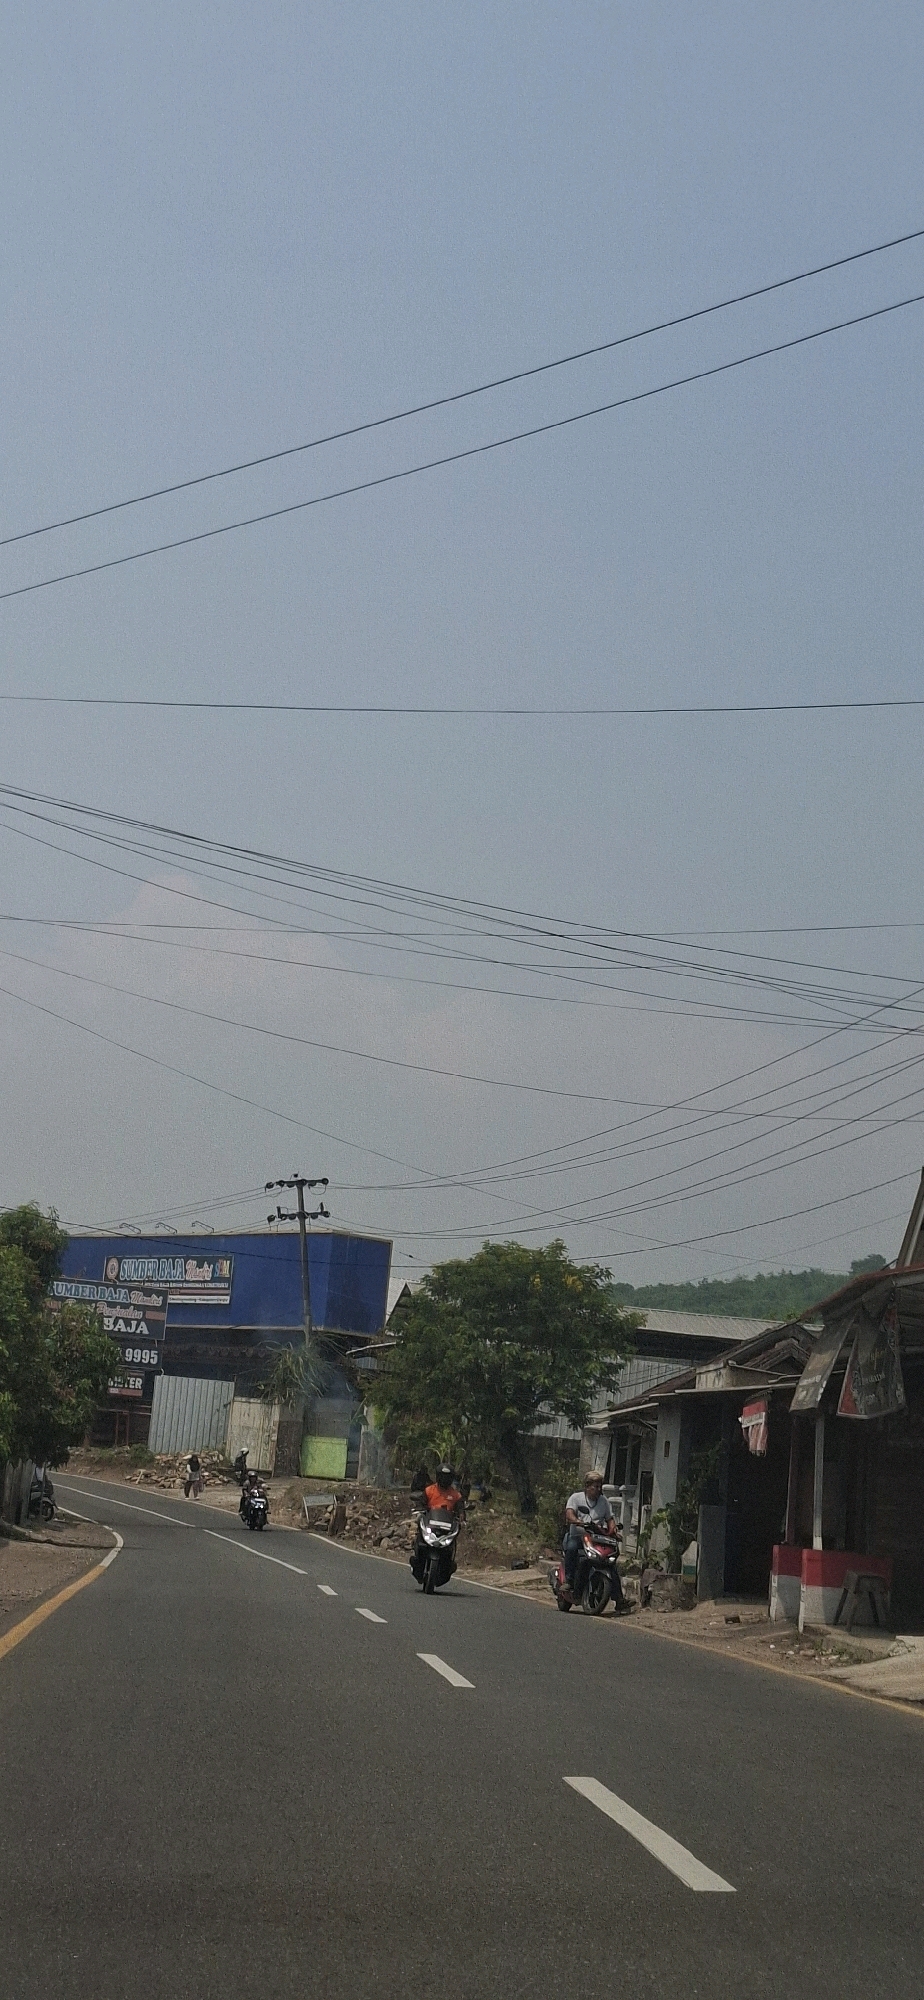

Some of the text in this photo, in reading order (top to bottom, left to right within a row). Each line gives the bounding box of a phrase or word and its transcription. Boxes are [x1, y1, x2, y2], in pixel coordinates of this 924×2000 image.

[120, 1258, 160, 1281] SUMBER
[159, 1258, 186, 1281] BAJA
[97, 1287, 131, 1304] BAJA
[103, 1317, 150, 1335] BAJA
[124, 1348, 159, 1365] 9995
